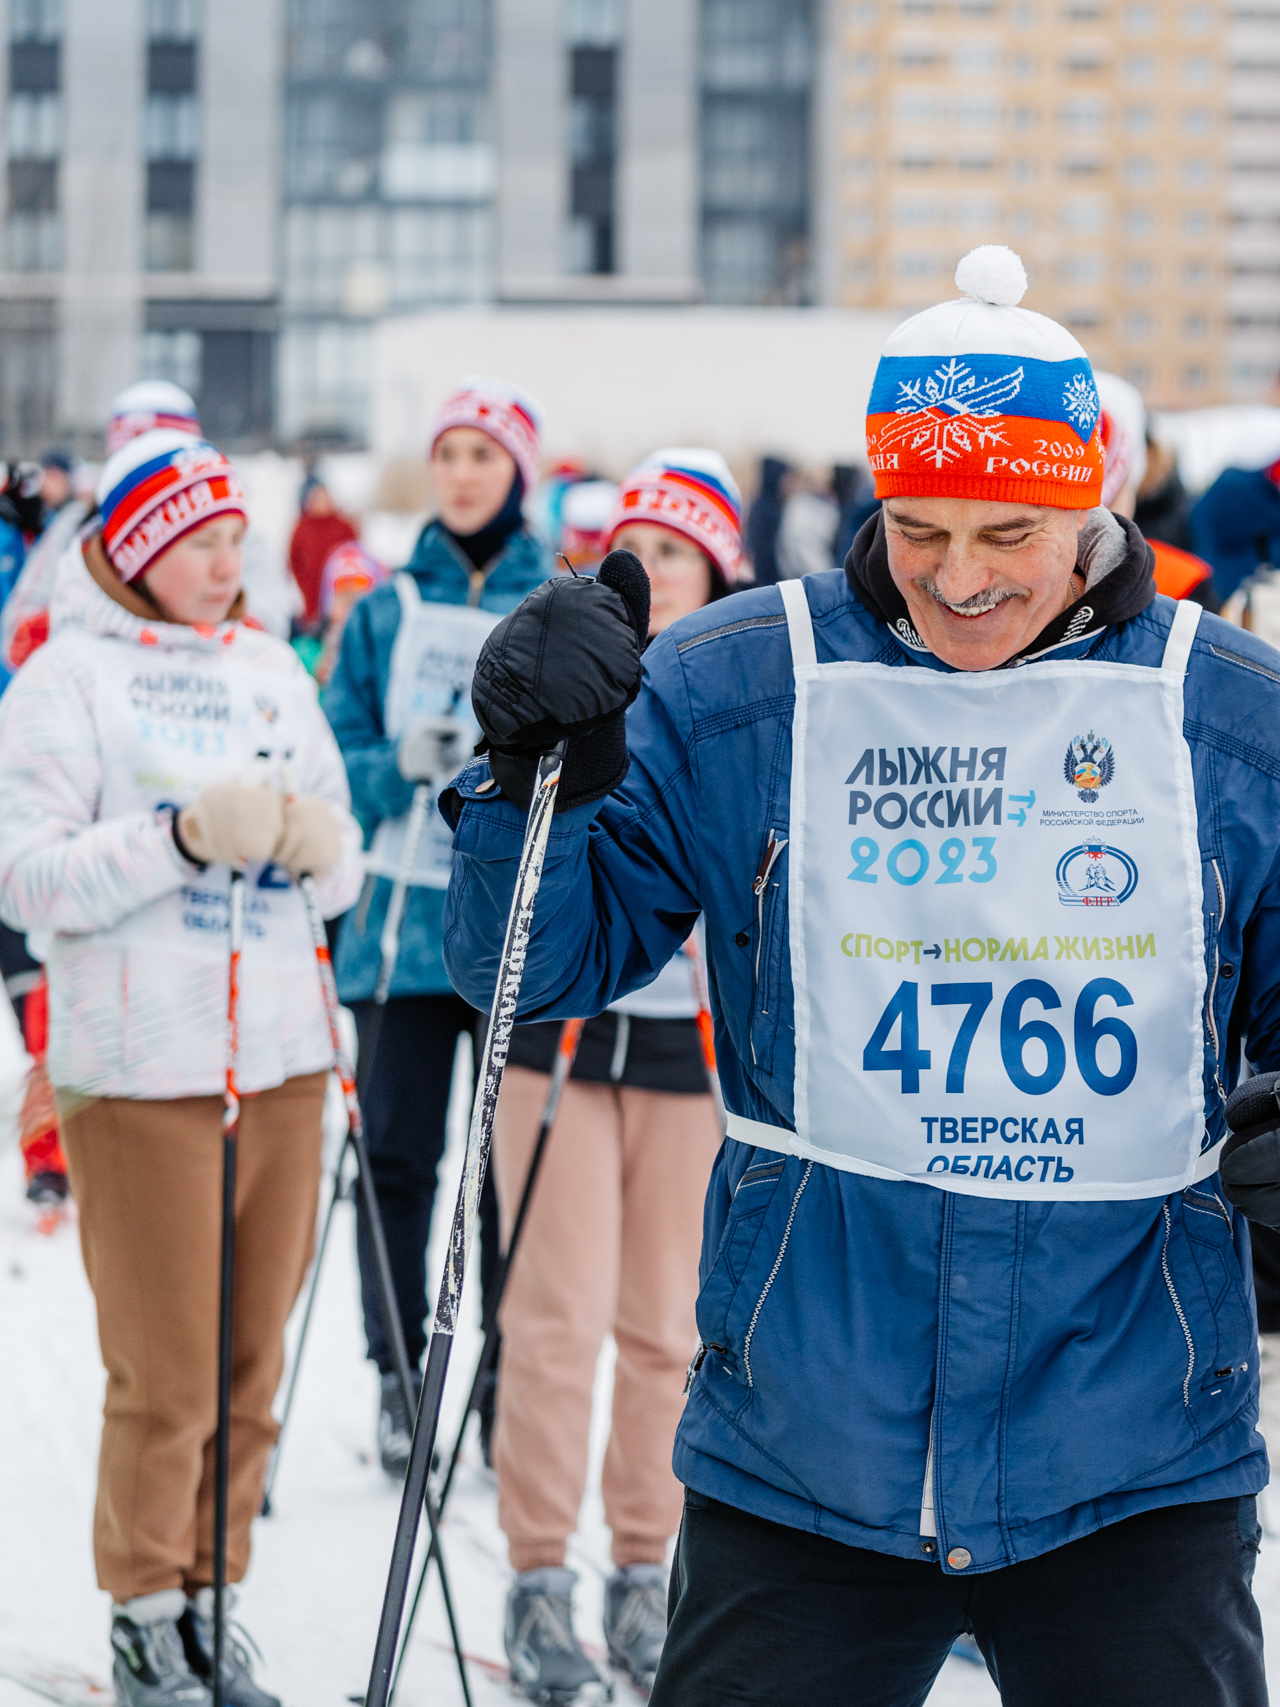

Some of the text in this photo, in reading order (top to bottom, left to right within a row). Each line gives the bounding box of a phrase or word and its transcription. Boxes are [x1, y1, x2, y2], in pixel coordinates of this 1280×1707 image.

[1034, 439, 1085, 460] 2009
[984, 456, 1094, 483] РОССИИ
[844, 746, 1007, 786] ЛЫЖНЯ
[848, 787, 1003, 830] РОССИИ
[1040, 817, 1144, 827] РОССИЙСКОЙ ФЕДЕРАЦИИ
[1042, 809, 1138, 818] МИНИСТЕРСТВО СПОРТА
[846, 836, 998, 886] 2023
[841, 933, 1157, 965] СПОРТ НОРМА ЖИЗНИ
[862, 977, 1138, 1096] 4766
[921, 1117, 1084, 1145] ТВЕРСКАЯ
[926, 1155, 1075, 1183] ОБЛАСТЬ
